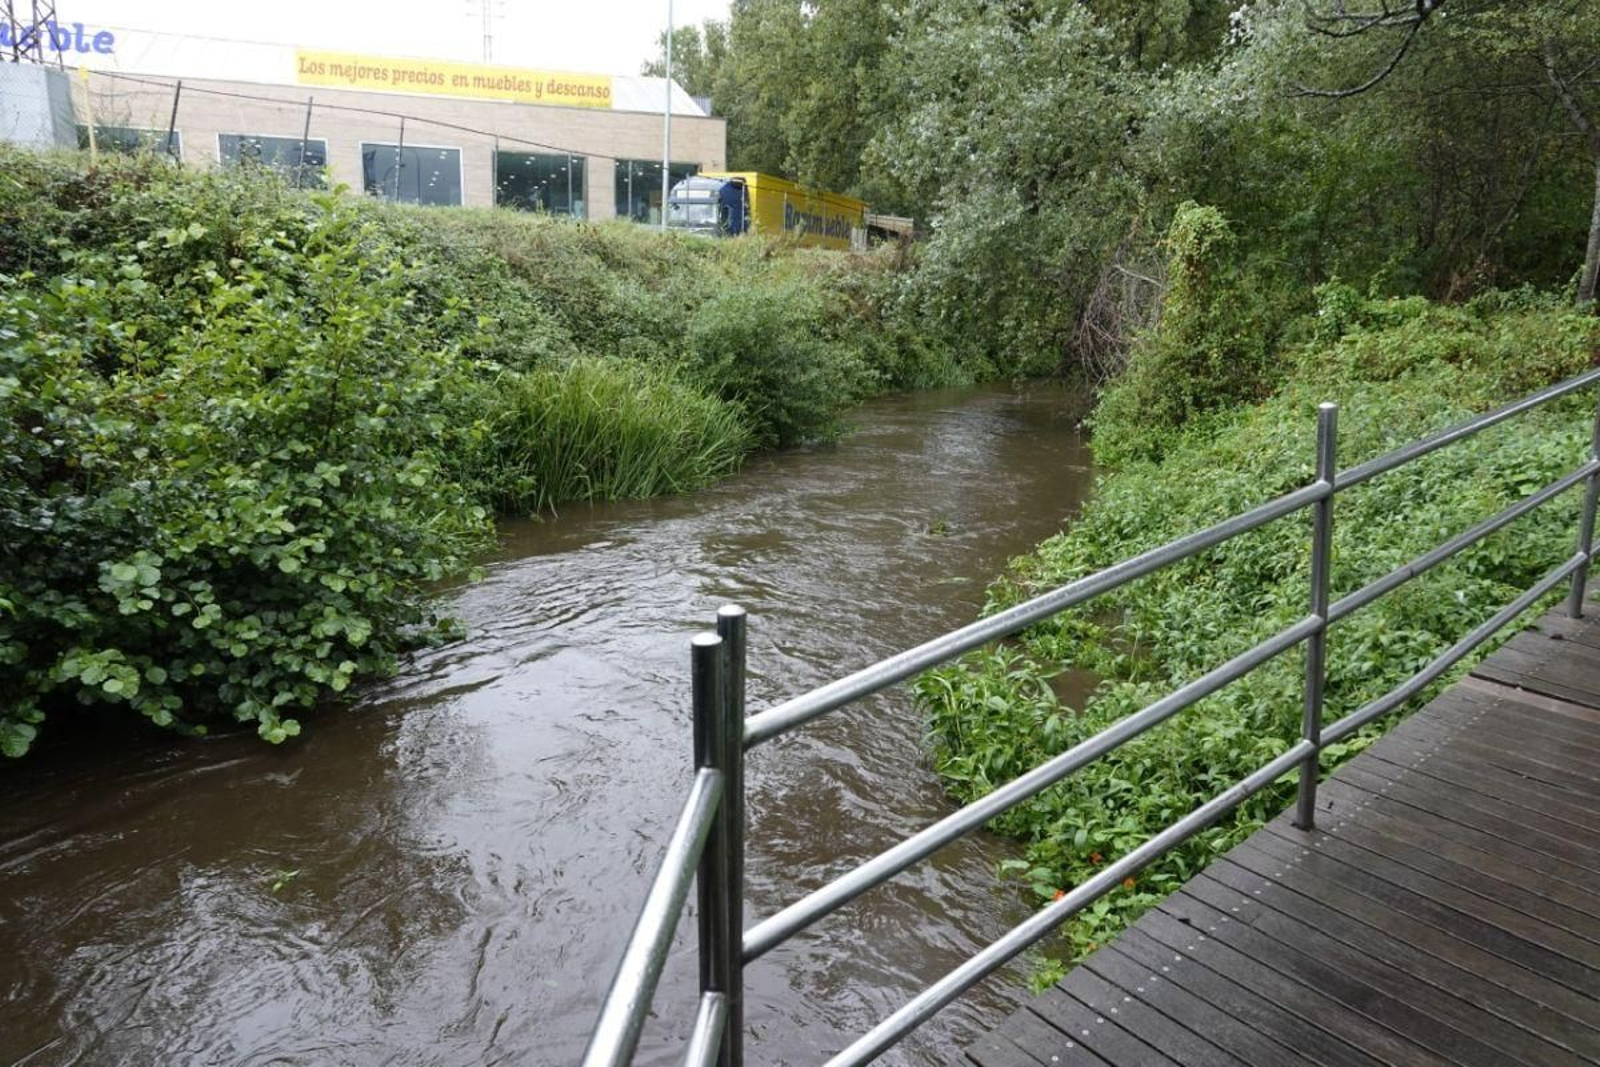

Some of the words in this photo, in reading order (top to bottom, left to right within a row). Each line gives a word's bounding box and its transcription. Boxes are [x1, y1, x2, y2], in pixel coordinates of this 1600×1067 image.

[298, 57, 326, 76] Los
[329, 61, 389, 83] mejores
[392, 67, 446, 86] precios
[451, 73, 470, 88] en
[472, 75, 532, 93] muebles
[535, 81, 544, 99] y
[547, 79, 611, 99] descanso
